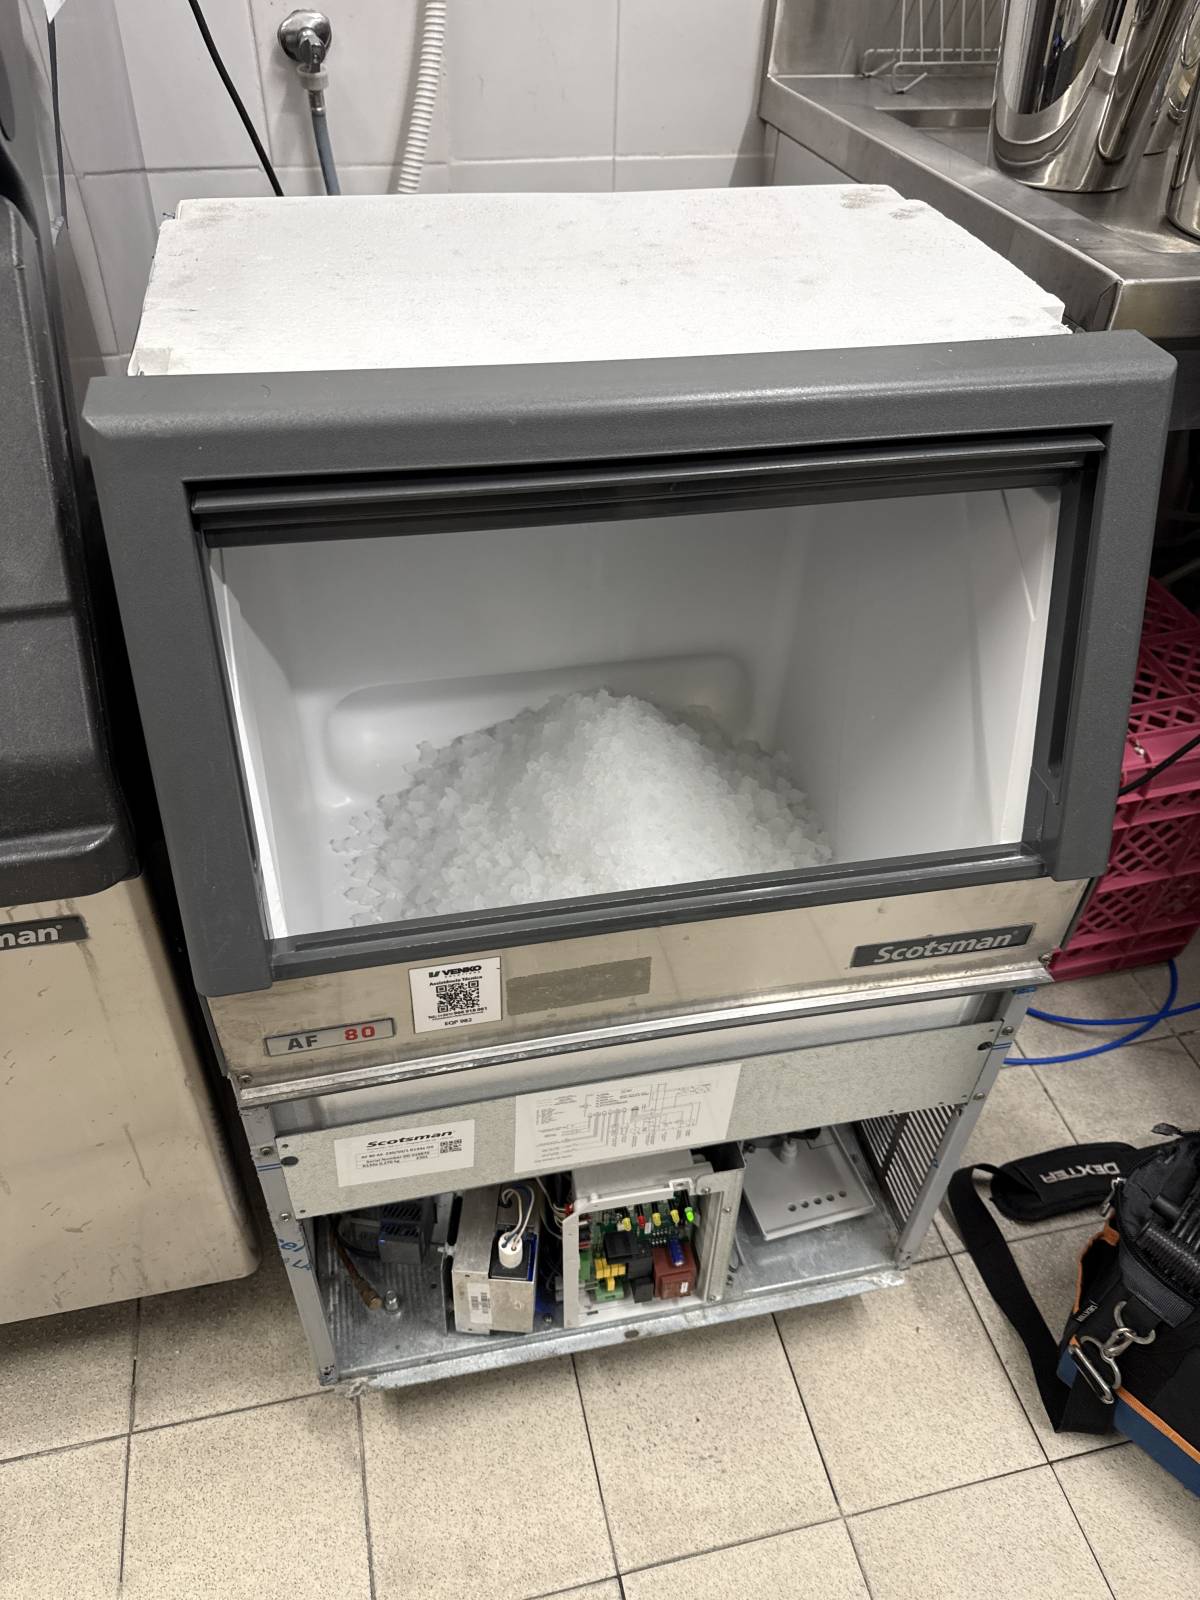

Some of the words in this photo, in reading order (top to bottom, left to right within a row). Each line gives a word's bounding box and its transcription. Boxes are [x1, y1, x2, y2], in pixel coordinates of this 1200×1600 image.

[874, 933, 1013, 963] Scotsman
[442, 965, 482, 976] VENKO
[288, 1035, 318, 1050] AF
[345, 1026, 375, 1041] 80
[367, 1131, 453, 1148] Scotsman
[1040, 1162, 1121, 1184] DEXTER
